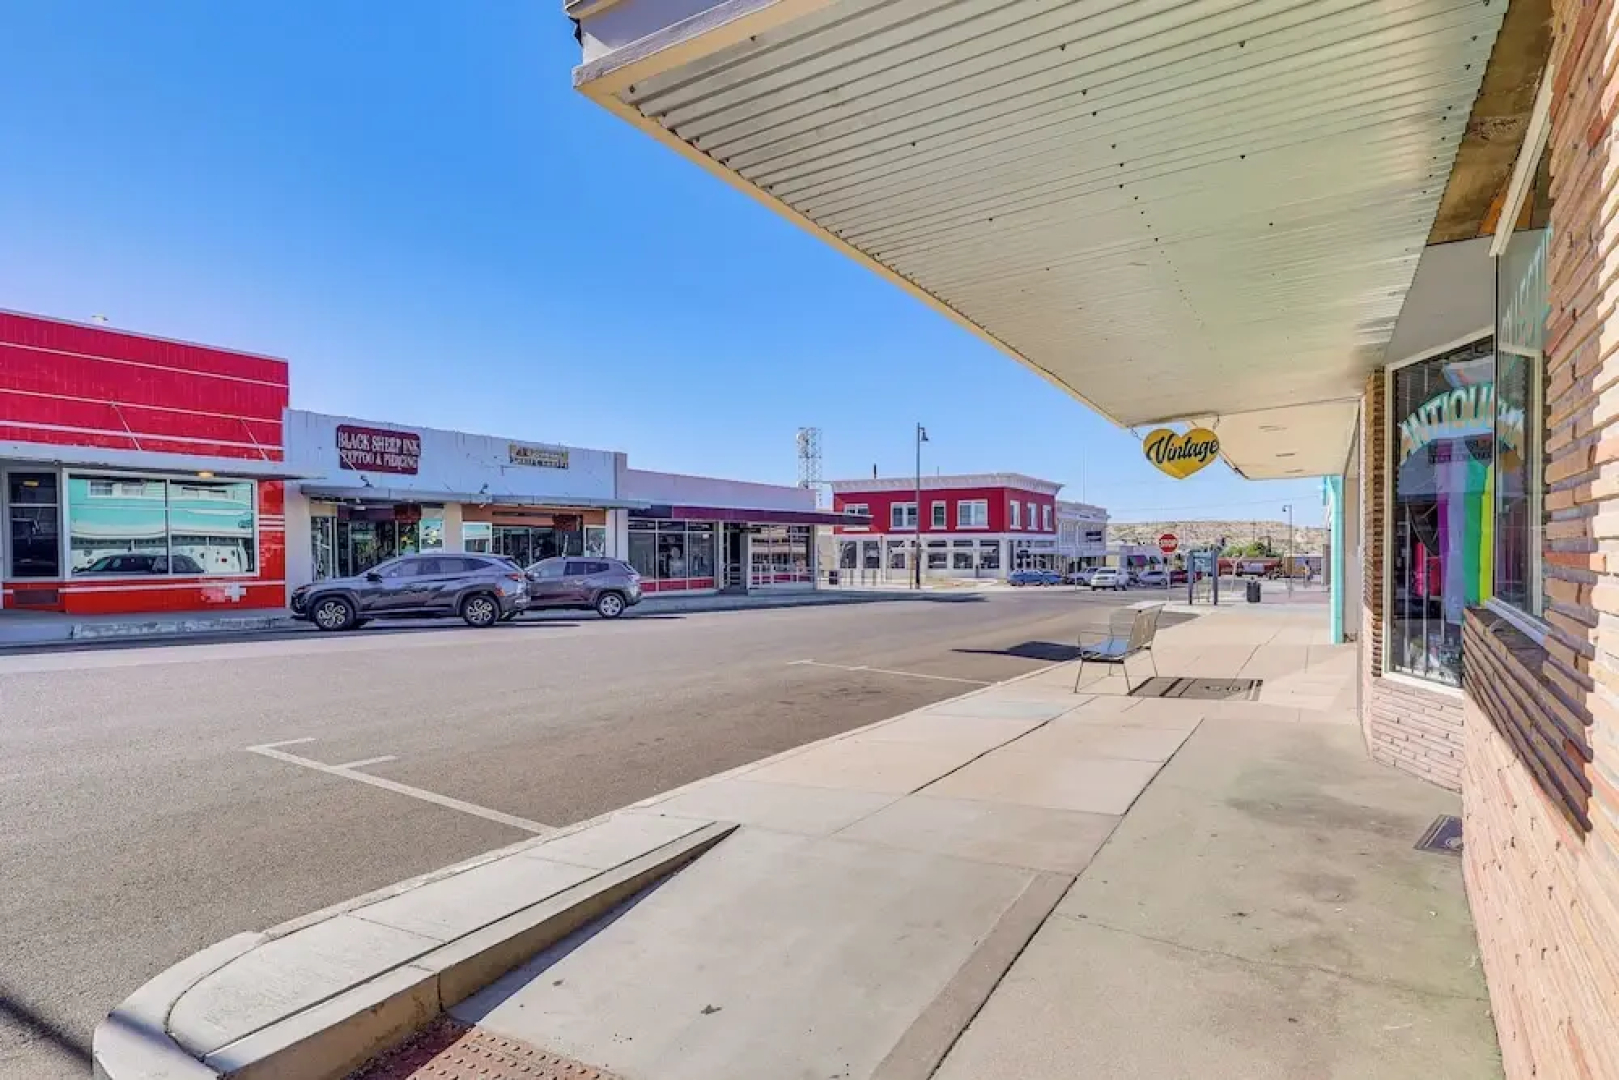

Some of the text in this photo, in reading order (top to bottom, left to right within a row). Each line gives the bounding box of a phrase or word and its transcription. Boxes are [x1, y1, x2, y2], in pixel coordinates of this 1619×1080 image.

[338, 432, 420, 455] BLACK SHEEP INK
[1146, 433, 1220, 464] Vintage
